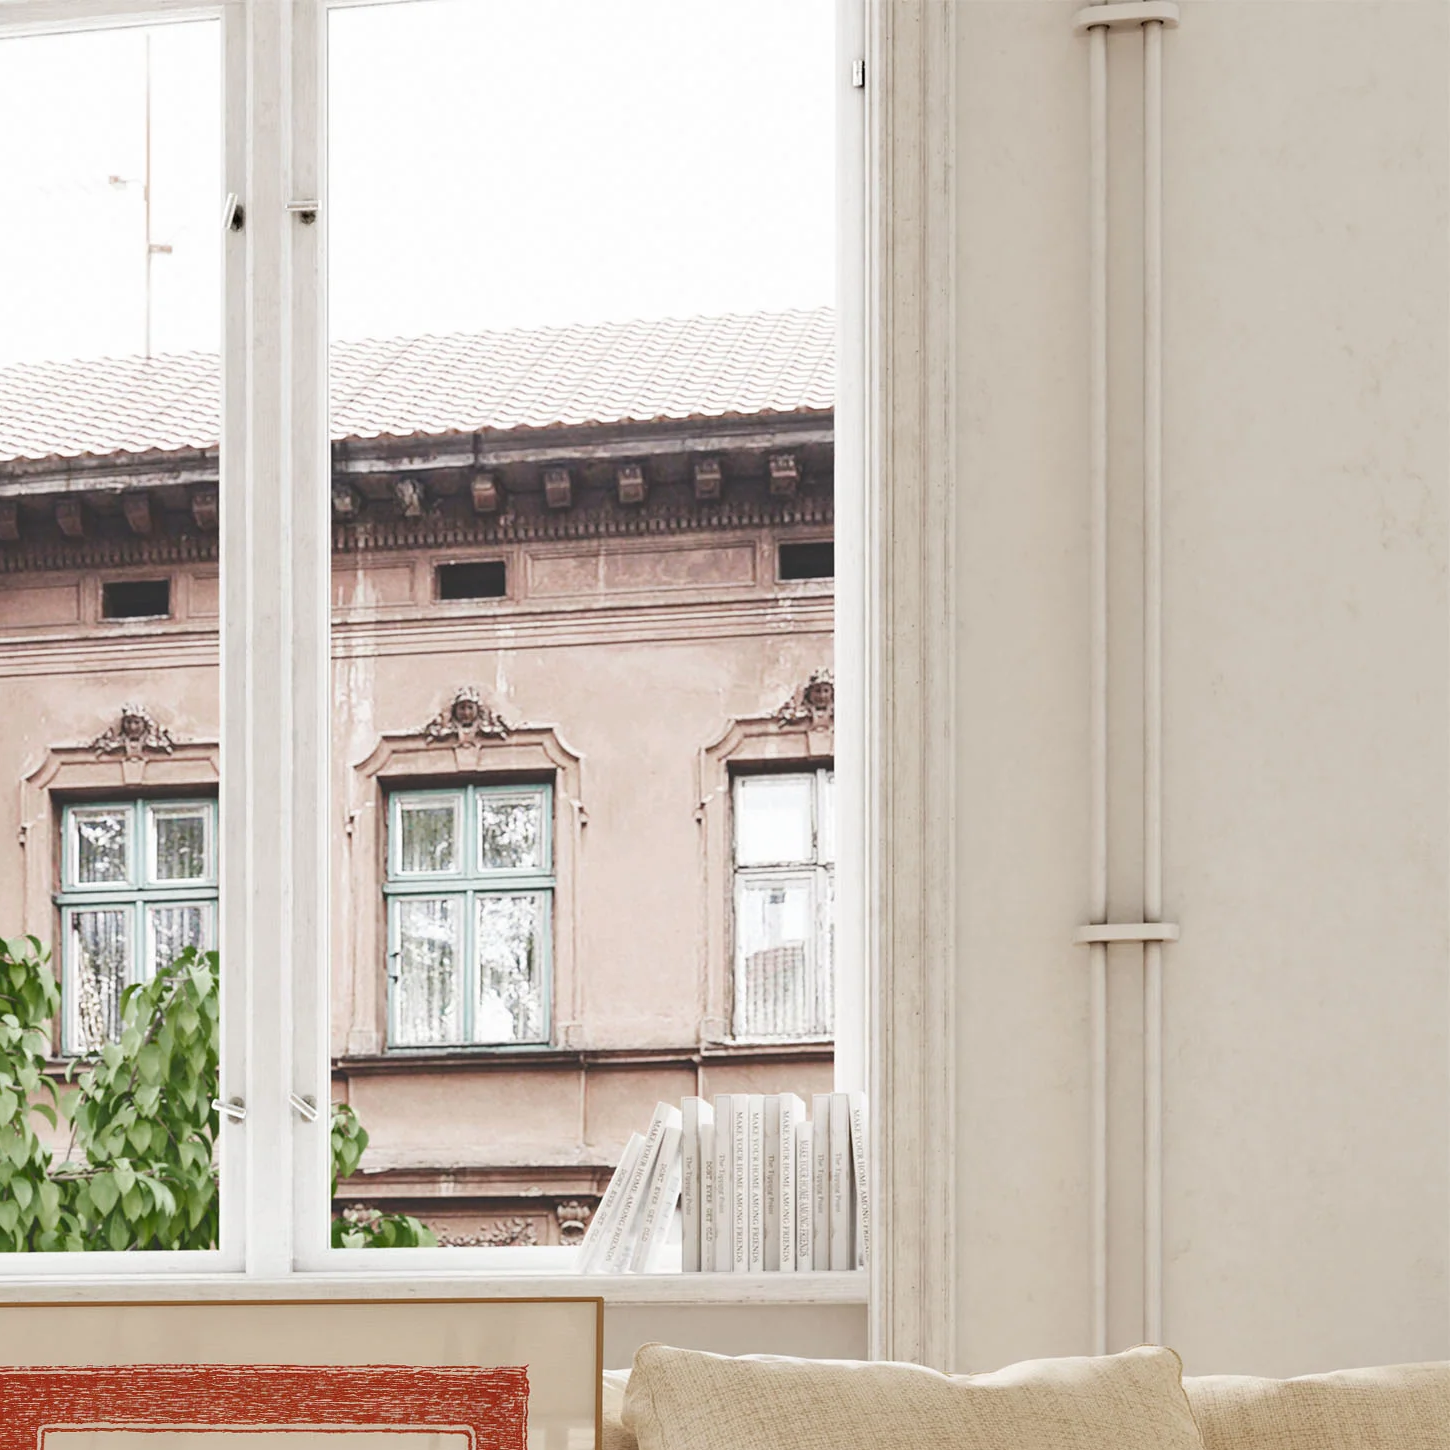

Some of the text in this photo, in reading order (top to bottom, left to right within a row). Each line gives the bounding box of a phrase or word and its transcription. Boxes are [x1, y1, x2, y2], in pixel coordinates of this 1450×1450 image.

[853, 1109, 862, 1133] MAKE
[640, 1143, 652, 1170] YOUR
[855, 1135, 864, 1160] YOUR
[685, 1156, 693, 1170] The
[766, 1155, 775, 1168] The
[858, 1161, 867, 1188] HOME
[632, 1167, 646, 1192] HOME
[736, 1111, 744, 1263] MAKE YOUR HOME AMONG FRIENDS
[752, 1112, 760, 1263] MAKE YOUR HOME AMONG FRIENDS
[782, 1110, 790, 1262] MAKE YOUR HOME AMONG FRIENDS
[621, 1192, 636, 1226] AMONG
[800, 1201, 809, 1227] AMONG
